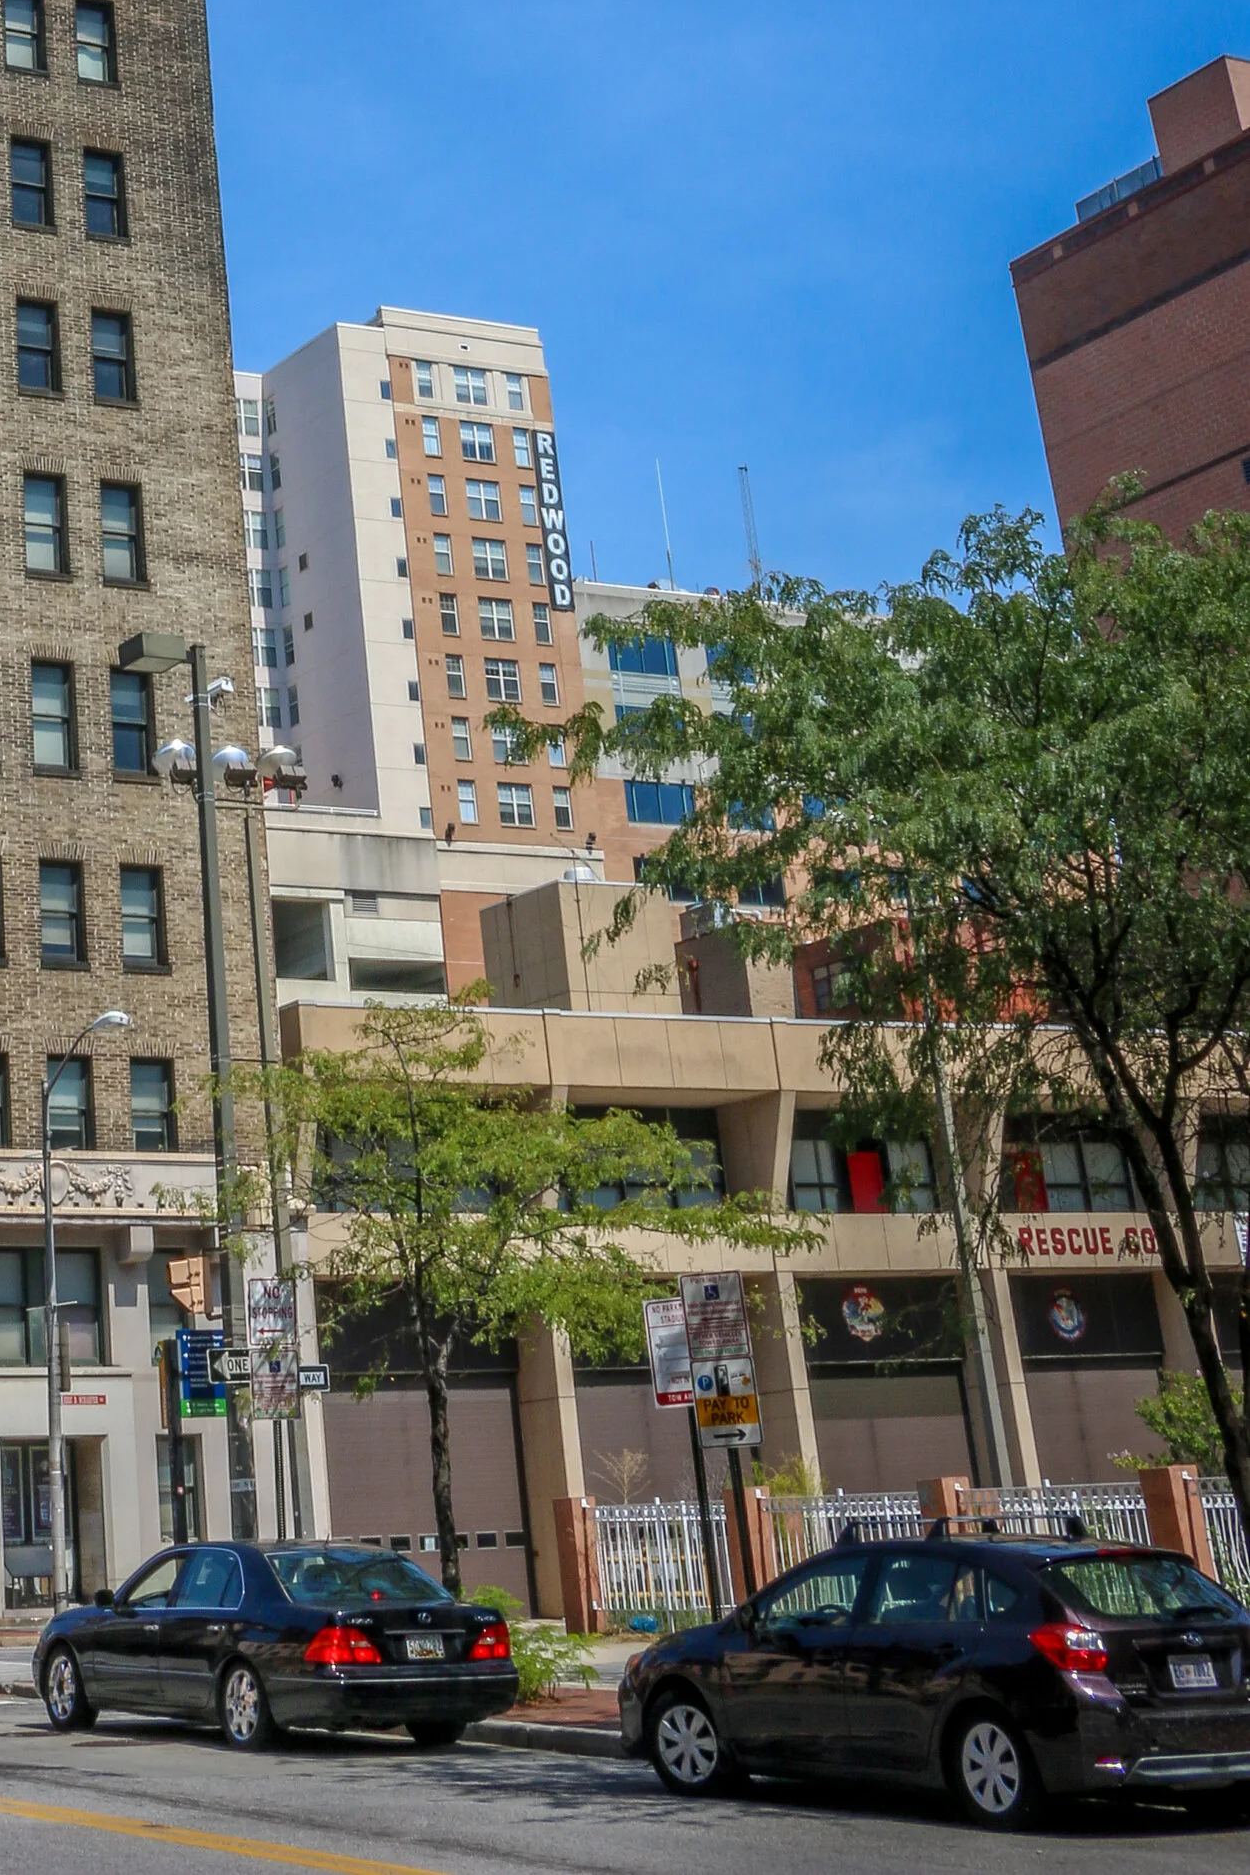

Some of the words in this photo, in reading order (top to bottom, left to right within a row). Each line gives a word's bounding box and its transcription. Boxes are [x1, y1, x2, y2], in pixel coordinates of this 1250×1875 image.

[536, 433, 572, 606] REDWOOD
[1019, 1227, 1114, 1256] RESCUE
[263, 1286, 280, 1300] NO
[252, 1306, 293, 1319] STOPPING
[652, 1305, 661, 1314] NO
[660, 1313, 685, 1325] STADIU
[227, 1359, 249, 1372] ONE
[304, 1372, 321, 1384] WAY
[703, 1376, 710, 1390] P
[668, 1394, 682, 1404] TOW
[703, 1398, 727, 1412] PAY
[734, 1396, 750, 1410] TO
[711, 1410, 745, 1424] PARK
